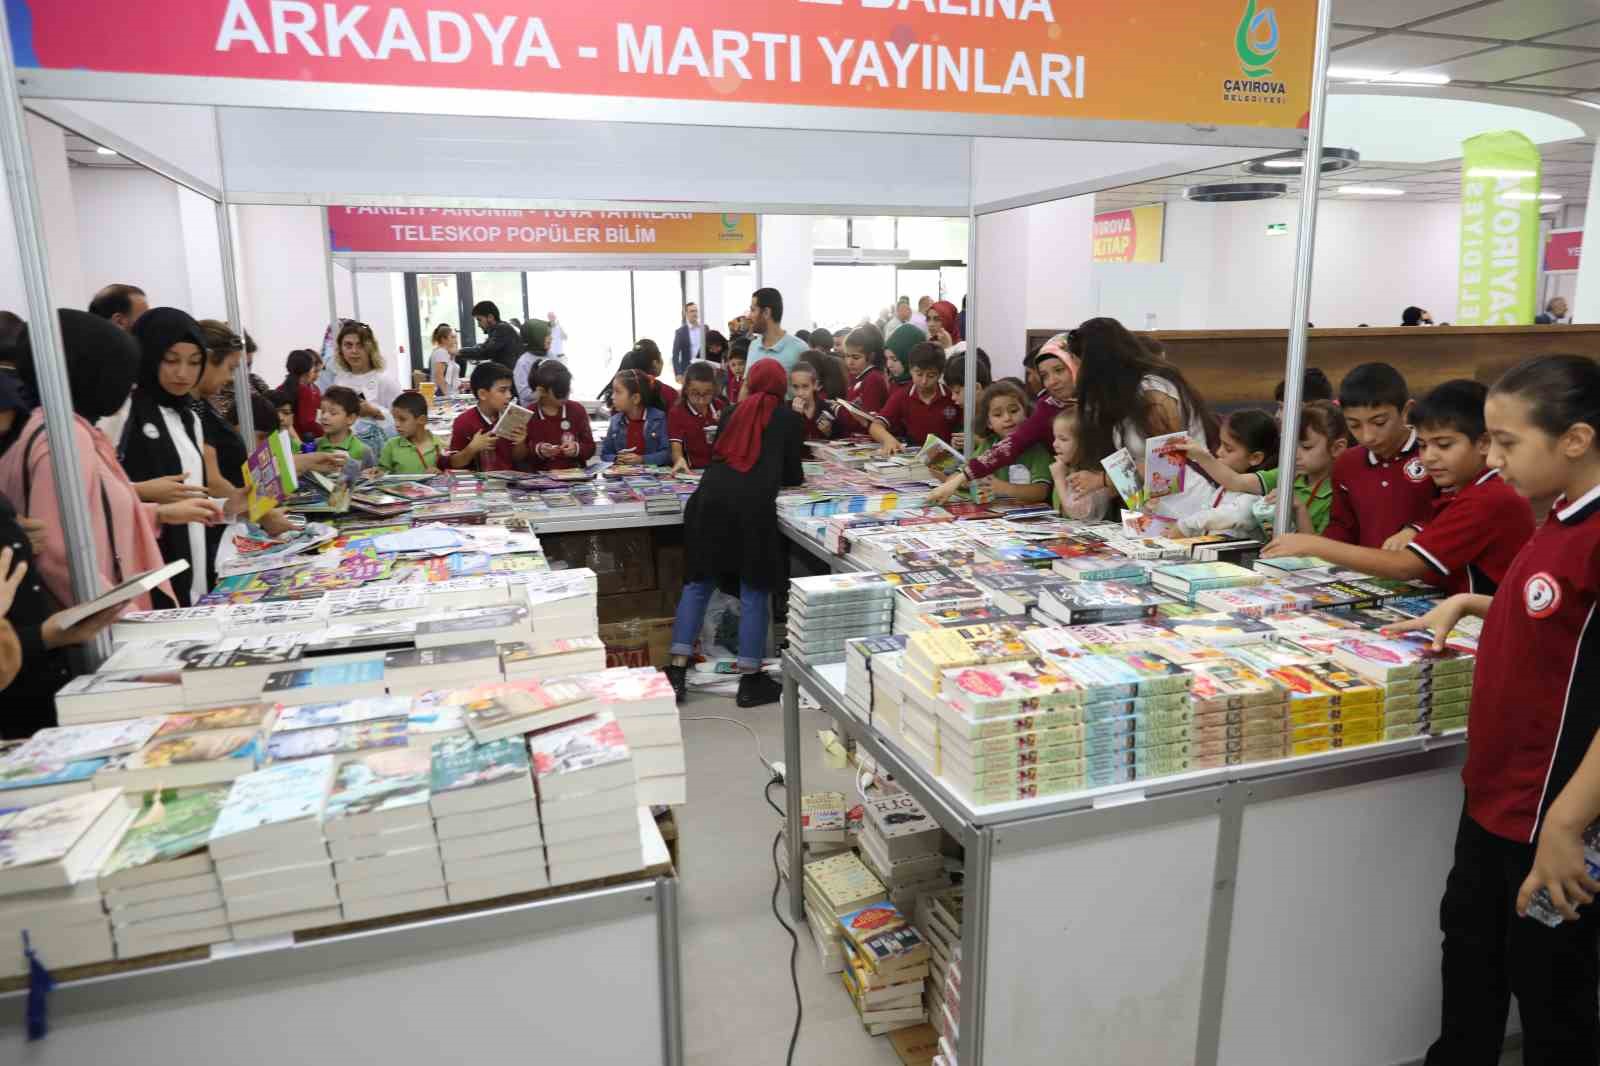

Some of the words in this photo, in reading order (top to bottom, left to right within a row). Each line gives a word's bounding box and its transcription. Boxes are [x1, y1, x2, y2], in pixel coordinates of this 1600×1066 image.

[215, 0, 562, 70] ARKADYA
[616, 22, 801, 82] MARTI
[817, 36, 1085, 99] YAYINLARI
[390, 224, 501, 243] TELESKOP
[506, 224, 600, 244] POPÜLER
[605, 224, 656, 244] BİLİM
